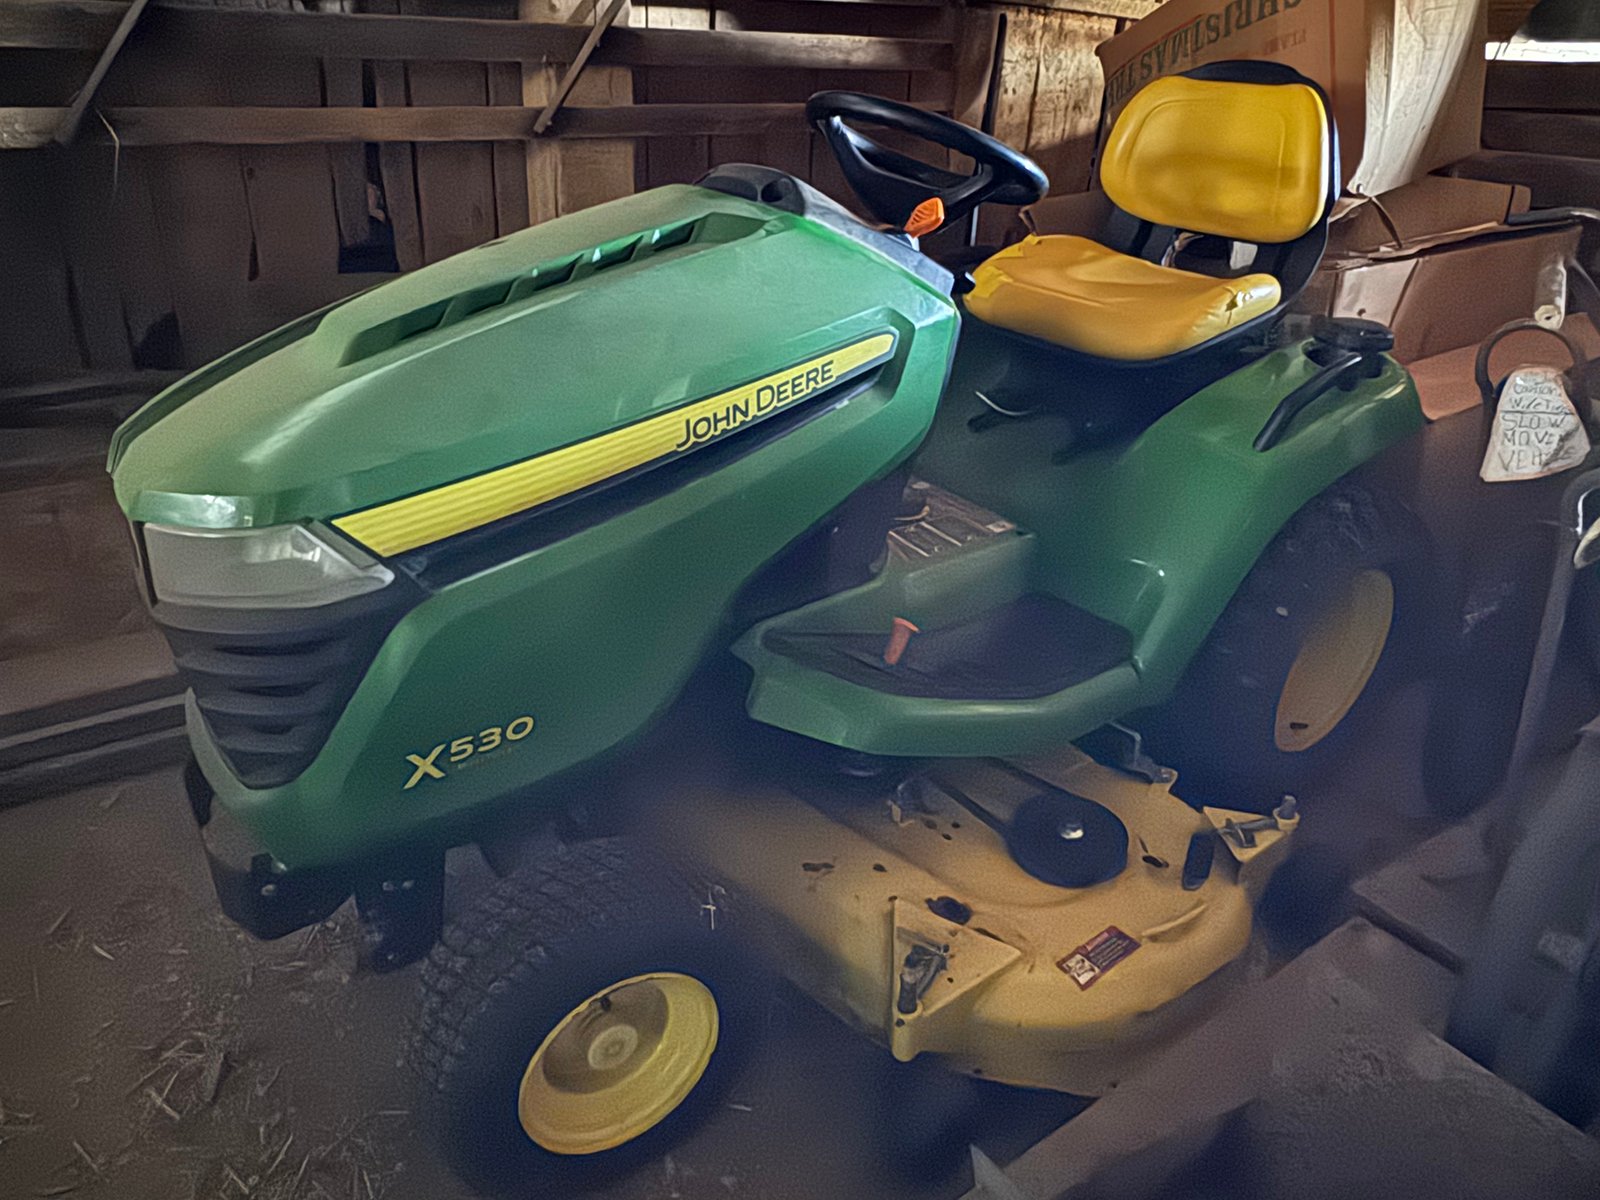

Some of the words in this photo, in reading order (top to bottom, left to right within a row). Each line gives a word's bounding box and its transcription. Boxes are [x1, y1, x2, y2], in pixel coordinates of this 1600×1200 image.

[676, 398, 749, 449] JOHN
[756, 360, 834, 413] DEERE
[1501, 413, 1566, 431] SLOW
[403, 716, 534, 789] X530
